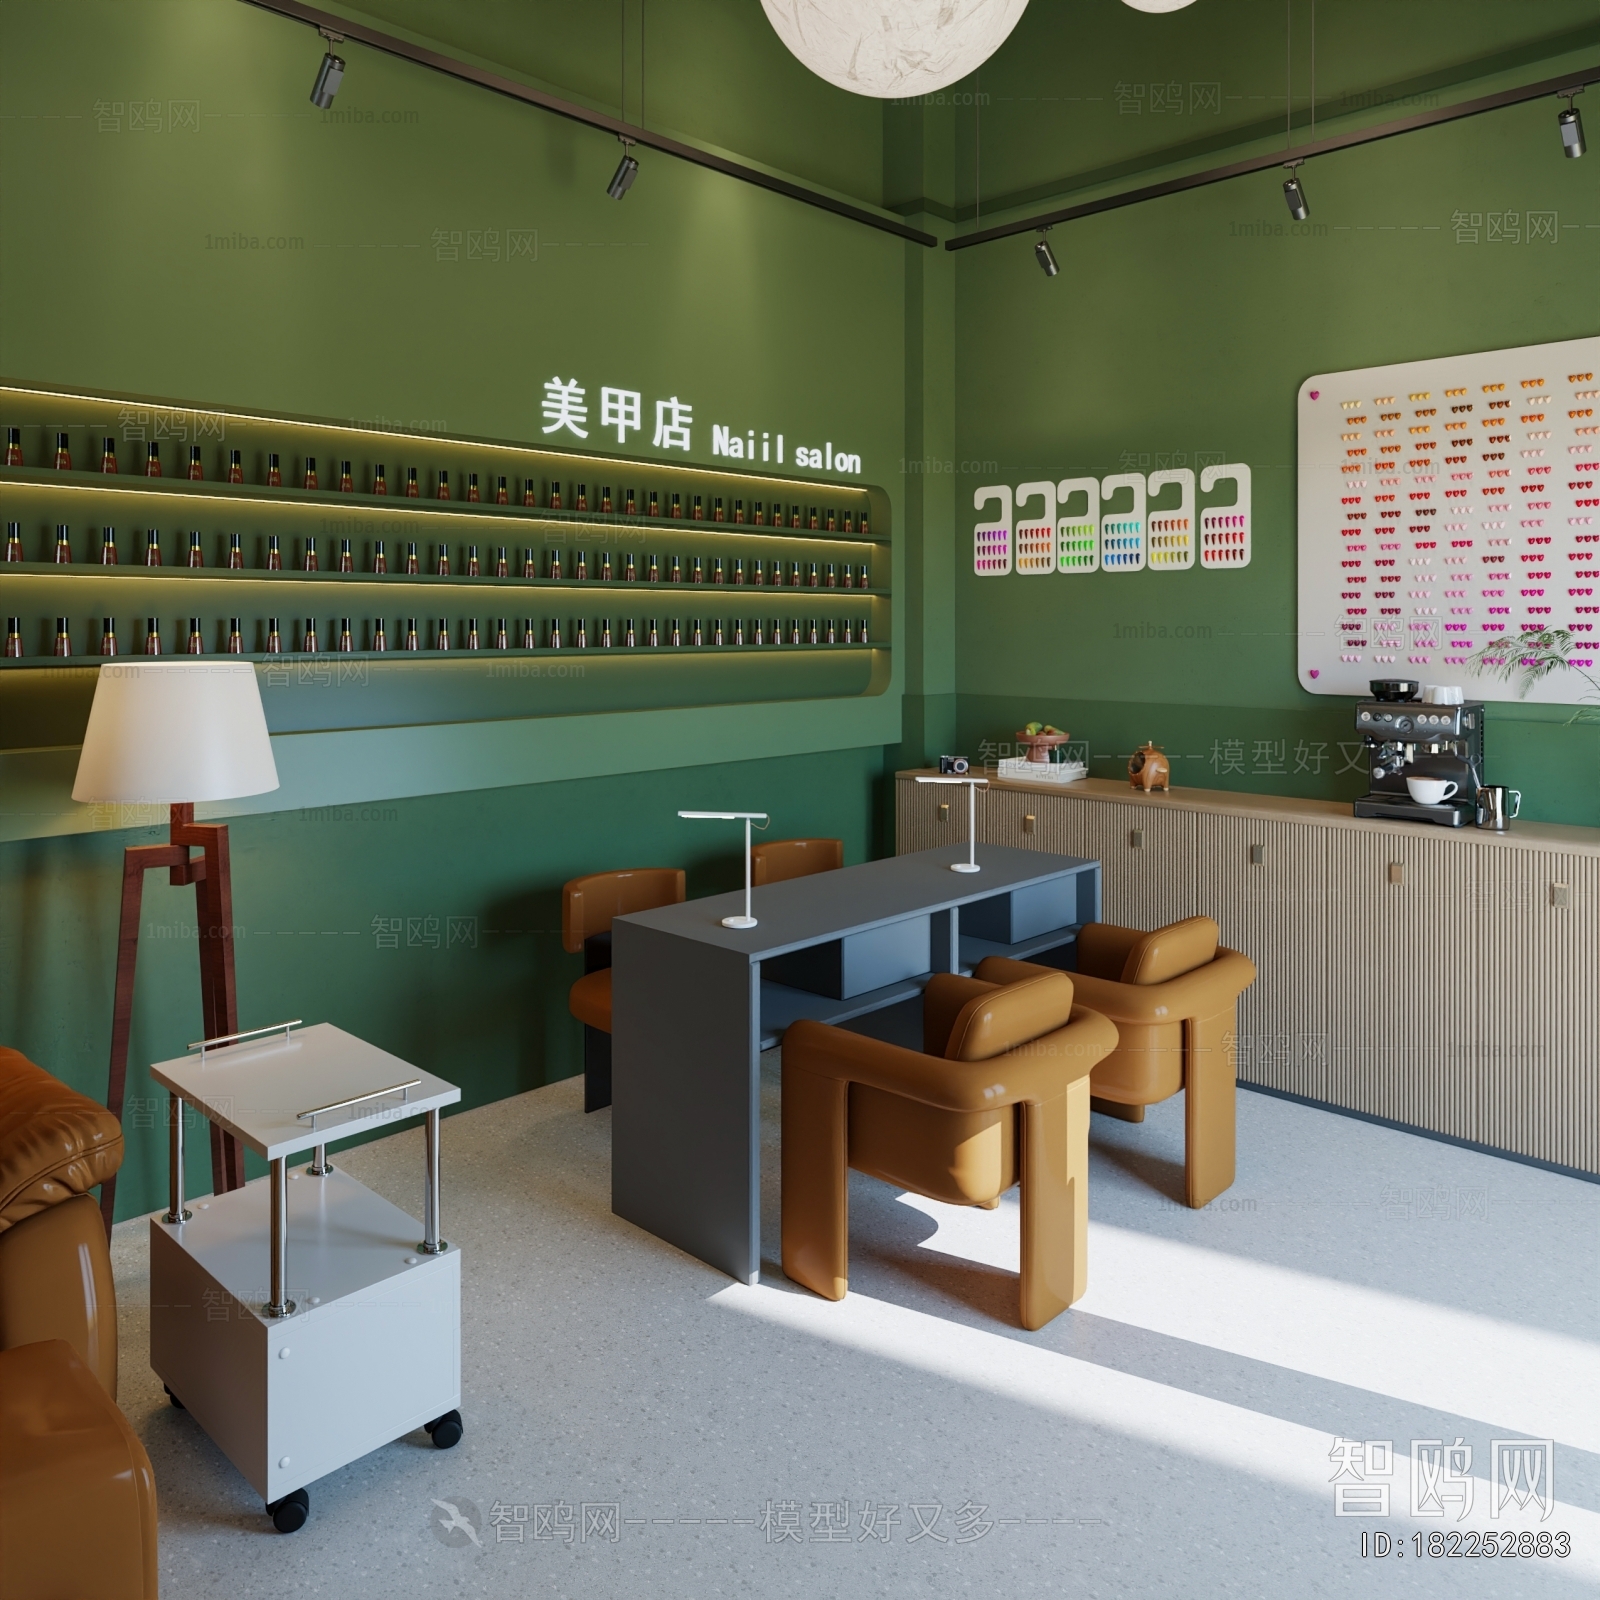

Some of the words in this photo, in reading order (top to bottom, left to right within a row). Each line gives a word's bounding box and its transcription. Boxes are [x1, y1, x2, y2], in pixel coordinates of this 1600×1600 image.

[541, 376, 693, 451] 美甲店
[712, 424, 784, 464] Naiil
[795, 442, 862, 474] salon
